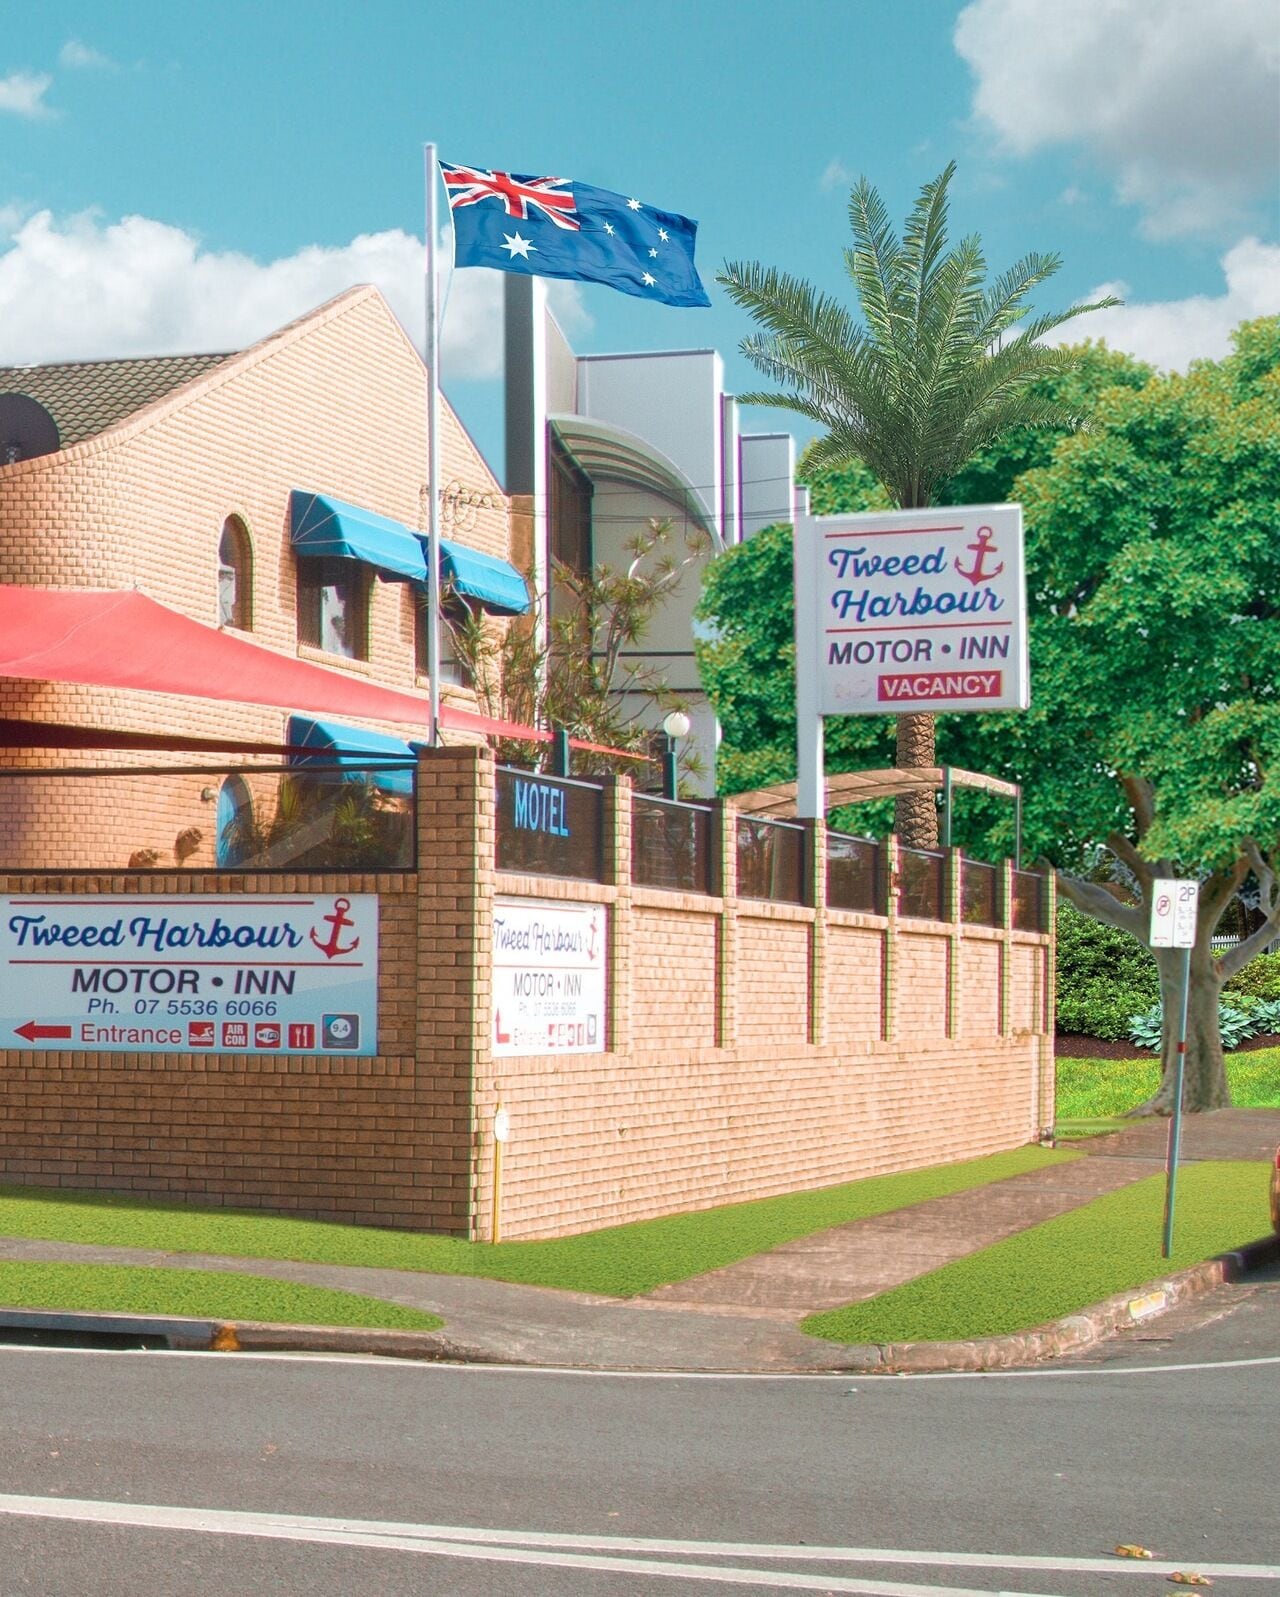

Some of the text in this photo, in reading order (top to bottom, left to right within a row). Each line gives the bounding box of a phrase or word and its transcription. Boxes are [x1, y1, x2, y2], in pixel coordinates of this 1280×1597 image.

[828, 546, 947, 579] Tweed
[831, 586, 1004, 622] Harbour
[828, 635, 1010, 665] MOTOR INN
[883, 675, 996, 697] VACANCY
[514, 780, 569, 837] MOTEL
[1179, 886, 1196, 902] 2P
[9, 915, 303, 952] Tweed Harbour
[493, 918, 583, 955] Tweed Harbour
[71, 968, 296, 995] MOTOR INN
[513, 973, 582, 997] MOTOR INN
[87, 997, 277, 1017] Ph. 07 5536 6066
[81, 1023, 182, 1045] Entrance
[227, 1024, 244, 1035] AIR
[332, 1023, 348, 1032] 9.4
[225, 1035, 246, 1045] CON
